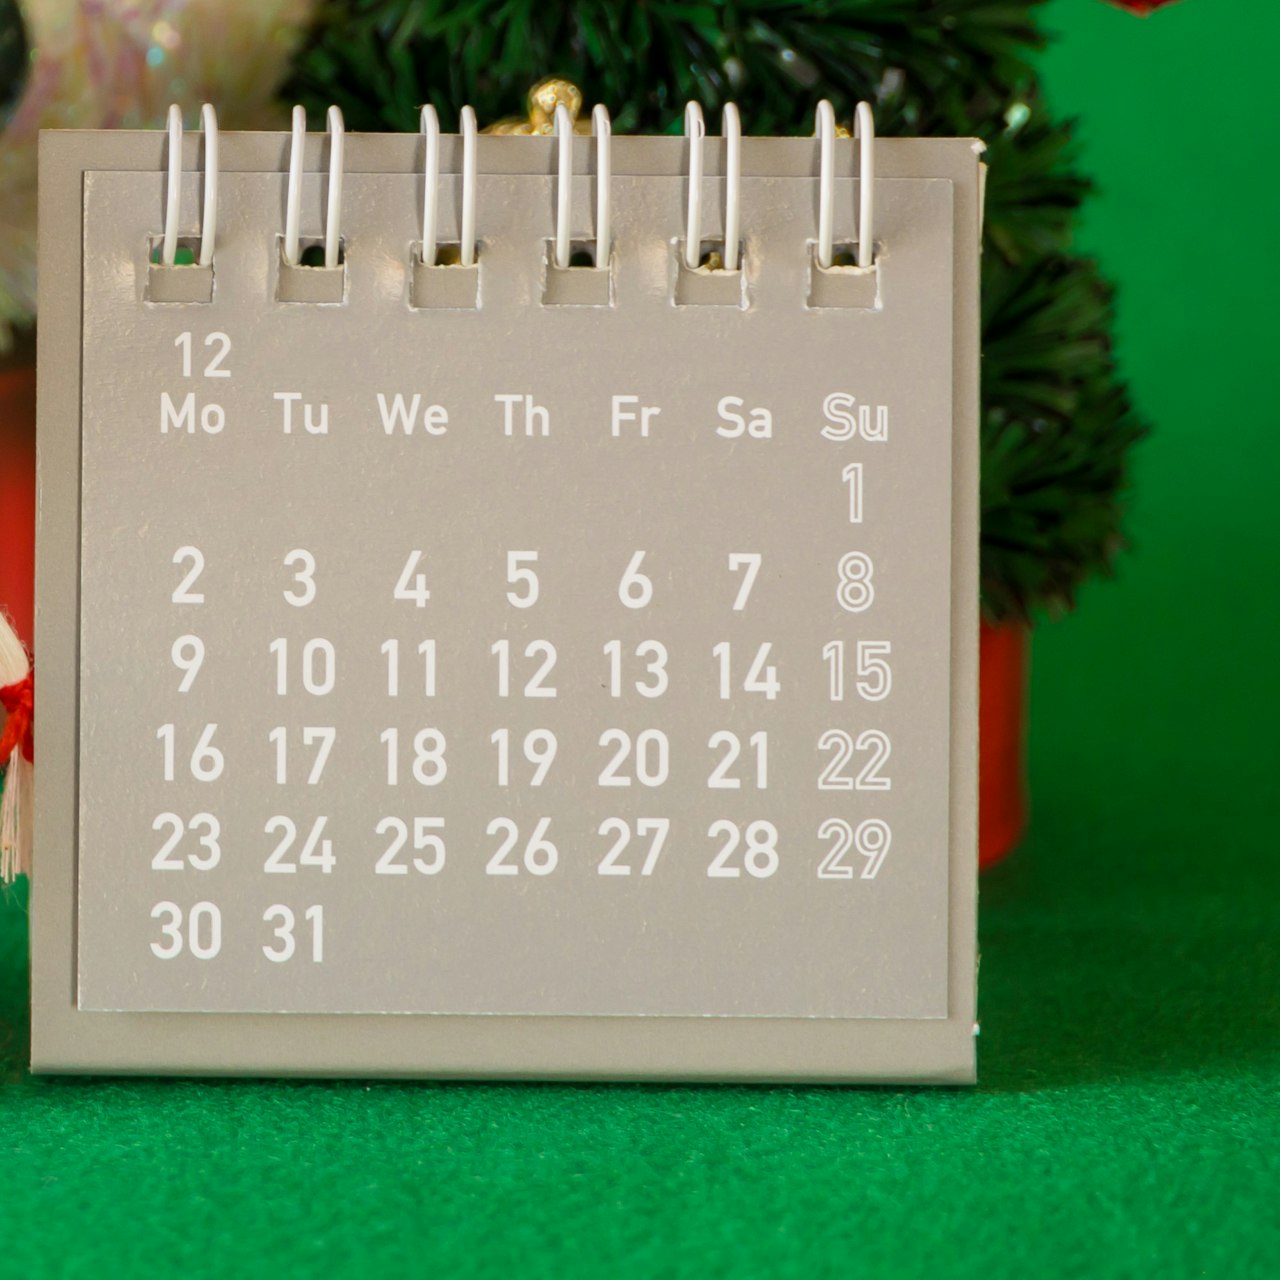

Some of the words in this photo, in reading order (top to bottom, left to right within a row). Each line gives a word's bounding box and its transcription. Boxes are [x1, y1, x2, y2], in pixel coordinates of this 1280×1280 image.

[175, 332, 231, 377] 12
[161, 392, 225, 434] Mo
[274, 392, 328, 434] Tu
[377, 393, 448, 435] We
[495, 395, 549, 436] Th
[612, 396, 661, 436] Fr
[716, 396, 772, 438] Sa
[821, 392, 888, 441] Su
[842, 463, 862, 523] 1
[172, 546, 204, 603] 2
[284, 549, 316, 606] 3
[394, 551, 430, 607] 4
[507, 551, 539, 608] 5
[619, 551, 652, 608] 6
[729, 553, 761, 610] 7
[837, 551, 874, 612] 8
[172, 635, 205, 692] 9
[270, 638, 335, 695] 10
[381, 639, 435, 696] 11
[492, 640, 557, 697] 12
[604, 640, 668, 697] 13
[713, 642, 780, 699] 14
[823, 641, 891, 701] 15
[157, 724, 224, 781] 16
[270, 727, 335, 784] 17
[381, 728, 447, 785] 18
[491, 729, 557, 786] 19
[599, 729, 669, 786] 20
[708, 731, 767, 788] 21
[818, 729, 891, 790] 22
[152, 812, 220, 870] 23
[264, 816, 336, 873] 24
[375, 817, 445, 875] 25
[486, 817, 558, 875] 26
[598, 817, 669, 875] 27
[707, 820, 779, 878] 28
[818, 818, 891, 879] 29
[150, 901, 221, 959] 30
[263, 904, 323, 962] 31
